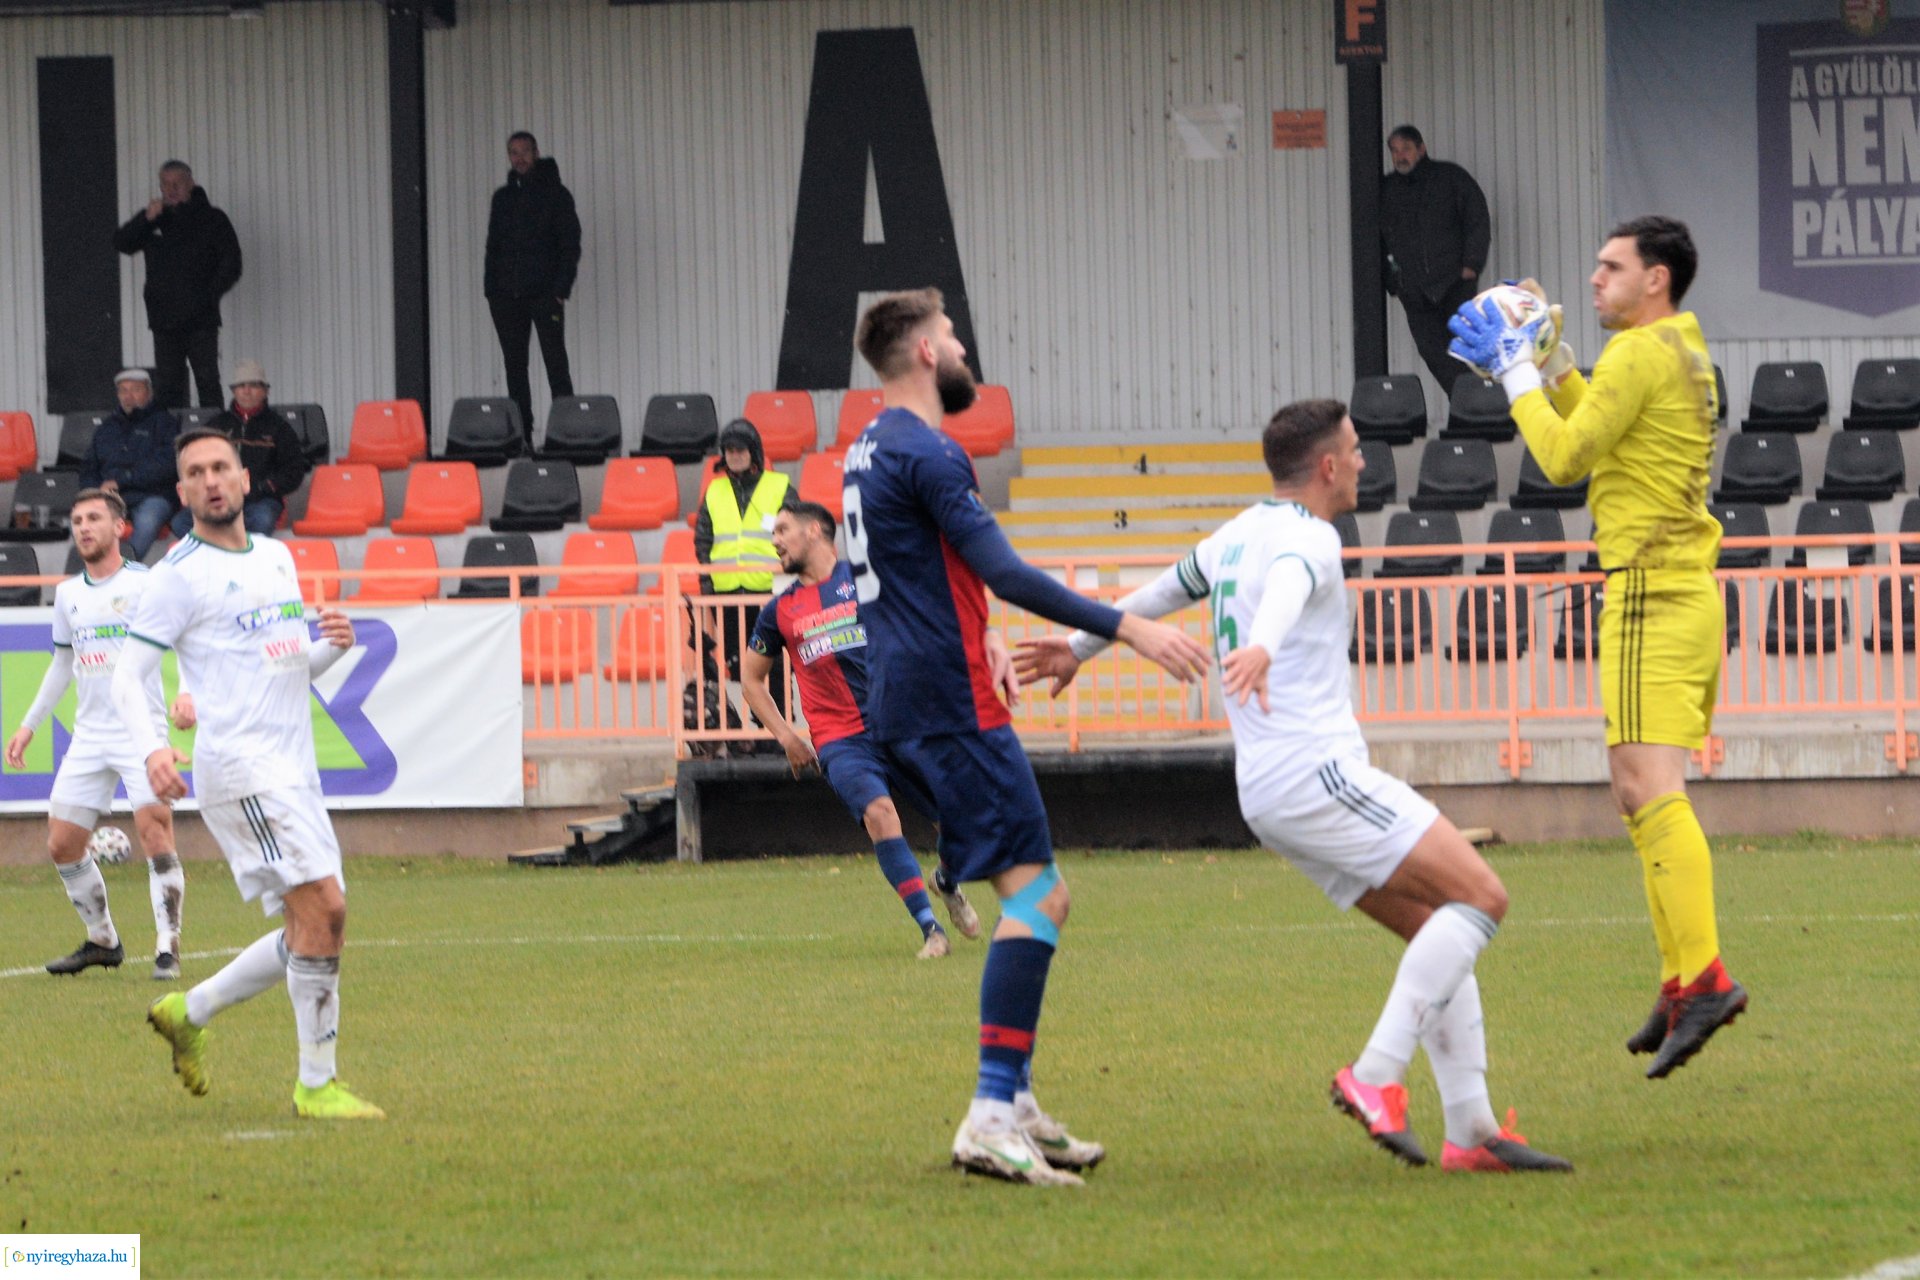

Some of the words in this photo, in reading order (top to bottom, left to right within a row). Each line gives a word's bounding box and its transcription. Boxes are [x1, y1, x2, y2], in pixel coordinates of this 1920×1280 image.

[1345, 0, 1377, 41] F
[1790, 65, 1809, 98] A
[776, 27, 984, 391] A
[1133, 453, 1148, 474] 4
[1114, 509, 1128, 529] 3
